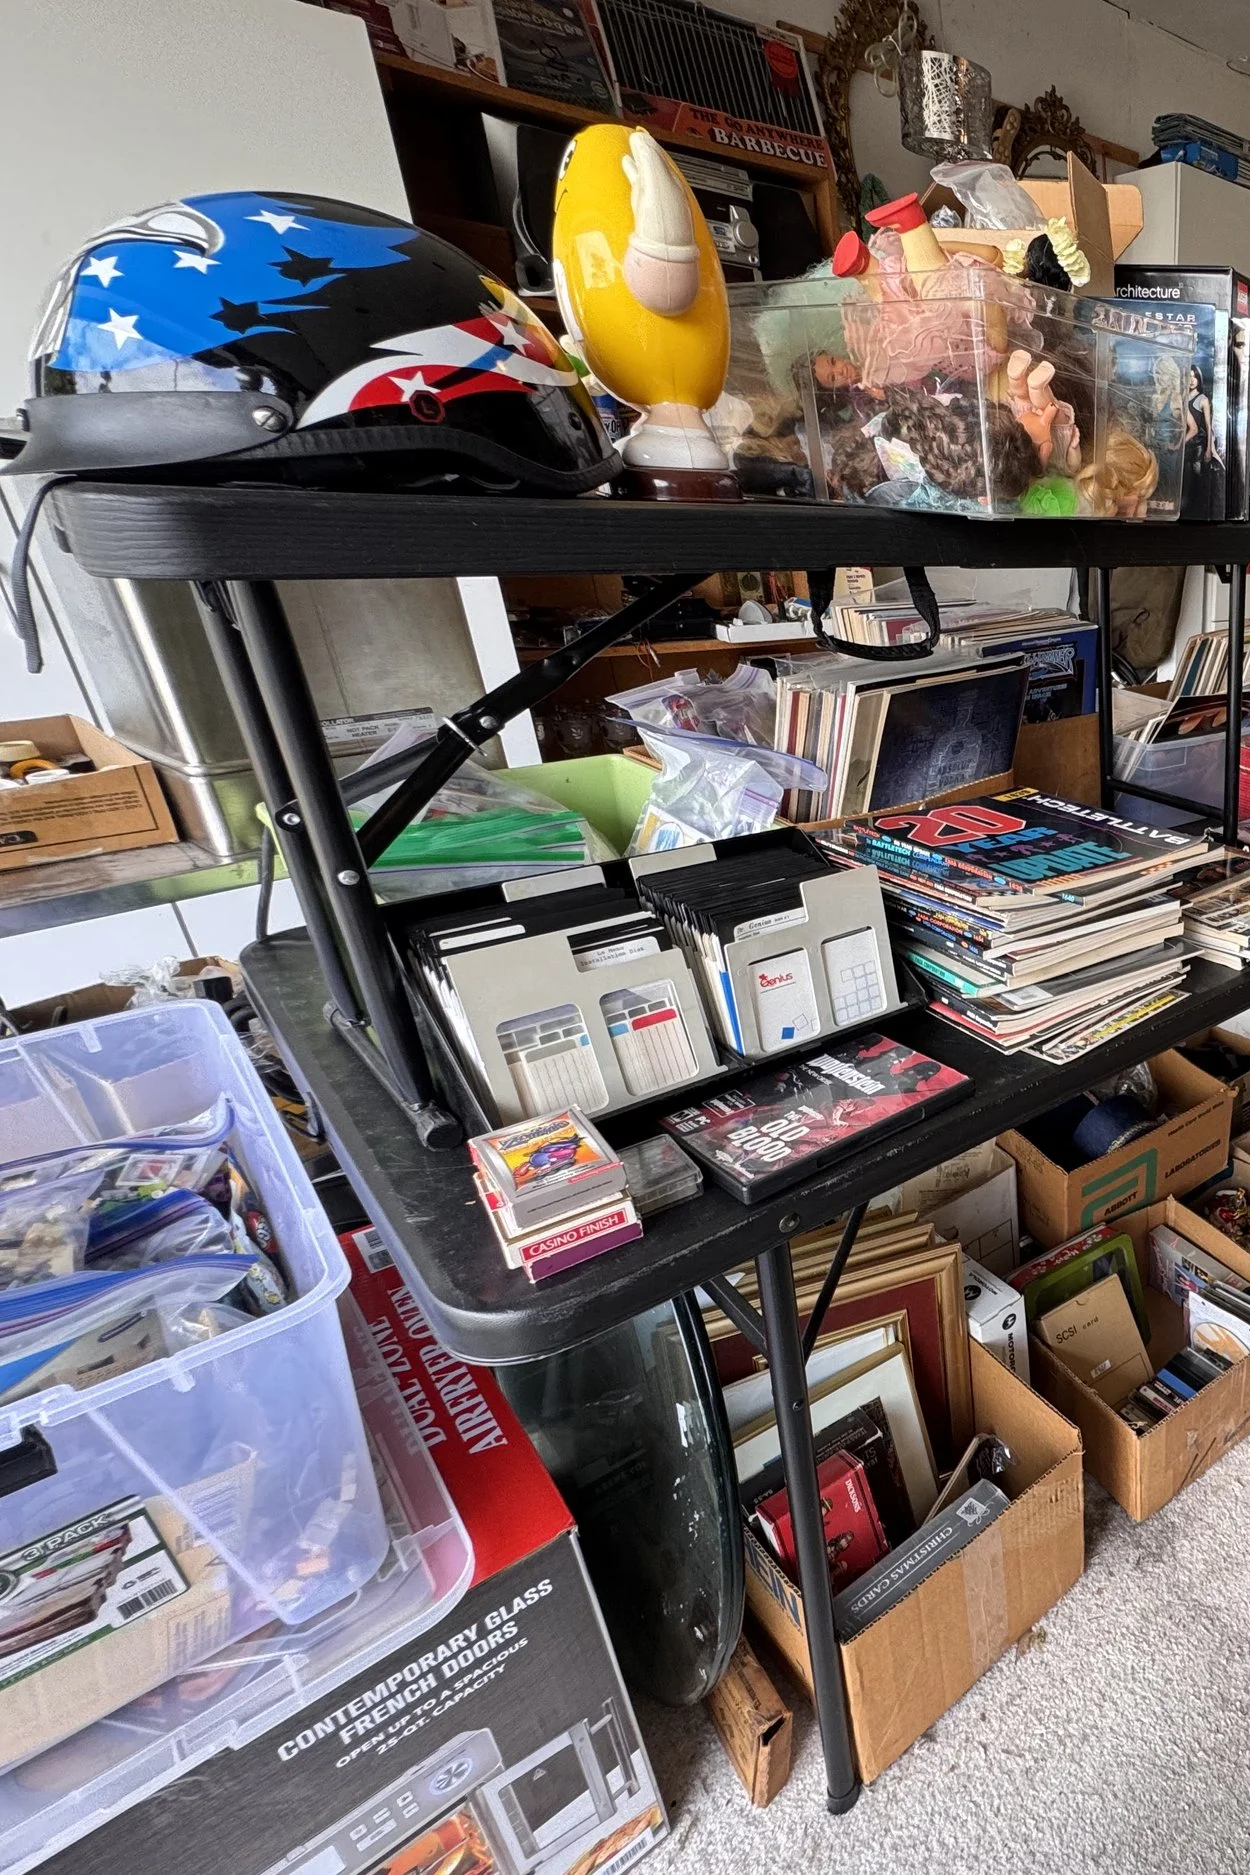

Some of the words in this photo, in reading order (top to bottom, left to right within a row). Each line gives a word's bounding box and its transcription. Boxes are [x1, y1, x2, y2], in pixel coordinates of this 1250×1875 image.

[689, 107, 720, 125] THE
[724, 117, 743, 131] GO
[746, 124, 824, 149] ANYWHERE
[712, 128, 828, 168] BARBECUE
[1115, 284, 1180, 298] rchitecture
[320, 718, 355, 726] OLLATOR
[875, 804, 1027, 847] 20
[946, 826, 1059, 854] YEAR
[1027, 795, 1191, 846] BATTLETECH
[872, 840, 910, 856] BATTLETECH
[989, 841, 1132, 881] UPDATE
[930, 917, 963, 935] CORPORATION
[758, 973, 793, 988] Genius
[806, 1054, 886, 1095] Wolfenstein
[726, 1126, 793, 1164] BLOOD
[760, 1117, 811, 1146] OLD
[1164, 1139, 1222, 1179] LABORATORIES
[1103, 1192, 1138, 1217] ABBOTT
[528, 1230, 577, 1256] CASINO
[579, 1213, 621, 1240] FINISH
[968, 1272, 999, 1296] MOTOROLA
[1056, 1325, 1078, 1345] SCSI
[1082, 1316, 1099, 1330] card
[370, 1316, 409, 1370] ZONE
[399, 1376, 447, 1447] DUAL
[386, 1287, 428, 1342] OVEN
[420, 1344, 508, 1456] AIRFRYER
[21, 1545, 42, 1562] 3
[45, 1512, 109, 1552] PACK
[891, 1526, 953, 1577] CHRISTMAS
[851, 1578, 891, 1614] CARDS
[277, 1624, 478, 1761] CONTEMPORARY
[484, 1579, 555, 1628] GLASS
[339, 1673, 438, 1745] FRENCH
[442, 1620, 518, 1679] DOORS
[335, 1731, 385, 1768] OPEN
[389, 1716, 413, 1734] UP
[413, 1699, 437, 1720] TO
[439, 1689, 453, 1701] A
[453, 1637, 529, 1690] SPACIOUS
[376, 1717, 432, 1755] 25-QT.
[432, 1663, 507, 1716] CAPACITY
